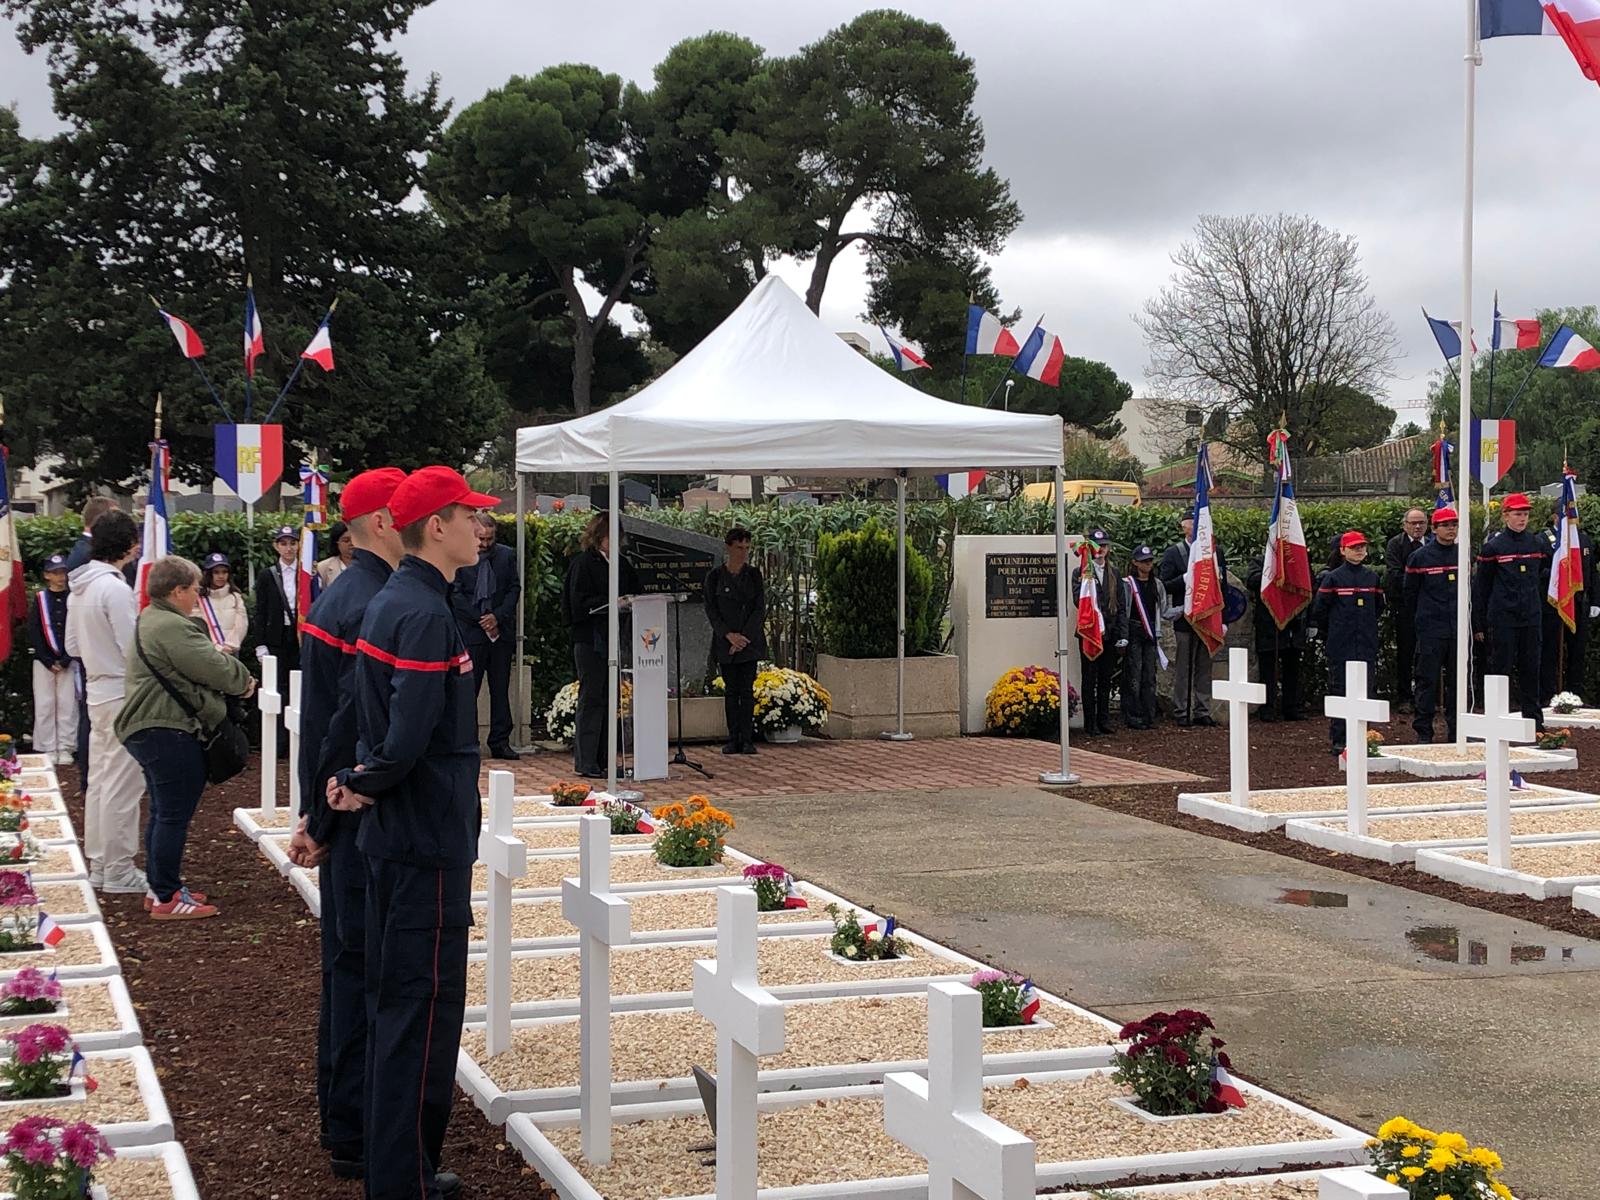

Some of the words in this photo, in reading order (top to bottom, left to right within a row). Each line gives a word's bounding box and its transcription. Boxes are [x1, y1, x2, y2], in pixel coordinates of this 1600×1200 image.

[1481, 439, 1499, 463] RF
[238, 446, 262, 474] RF
[990, 557, 1003, 565] AUX
[997, 567, 1017, 575] POUR
[1018, 567, 1027, 575] LA
[1028, 567, 1057, 575] FRANCE
[1006, 577, 1016, 585] EN
[1017, 577, 1048, 585] ALGERIE
[637, 655, 664, 667] lunel
